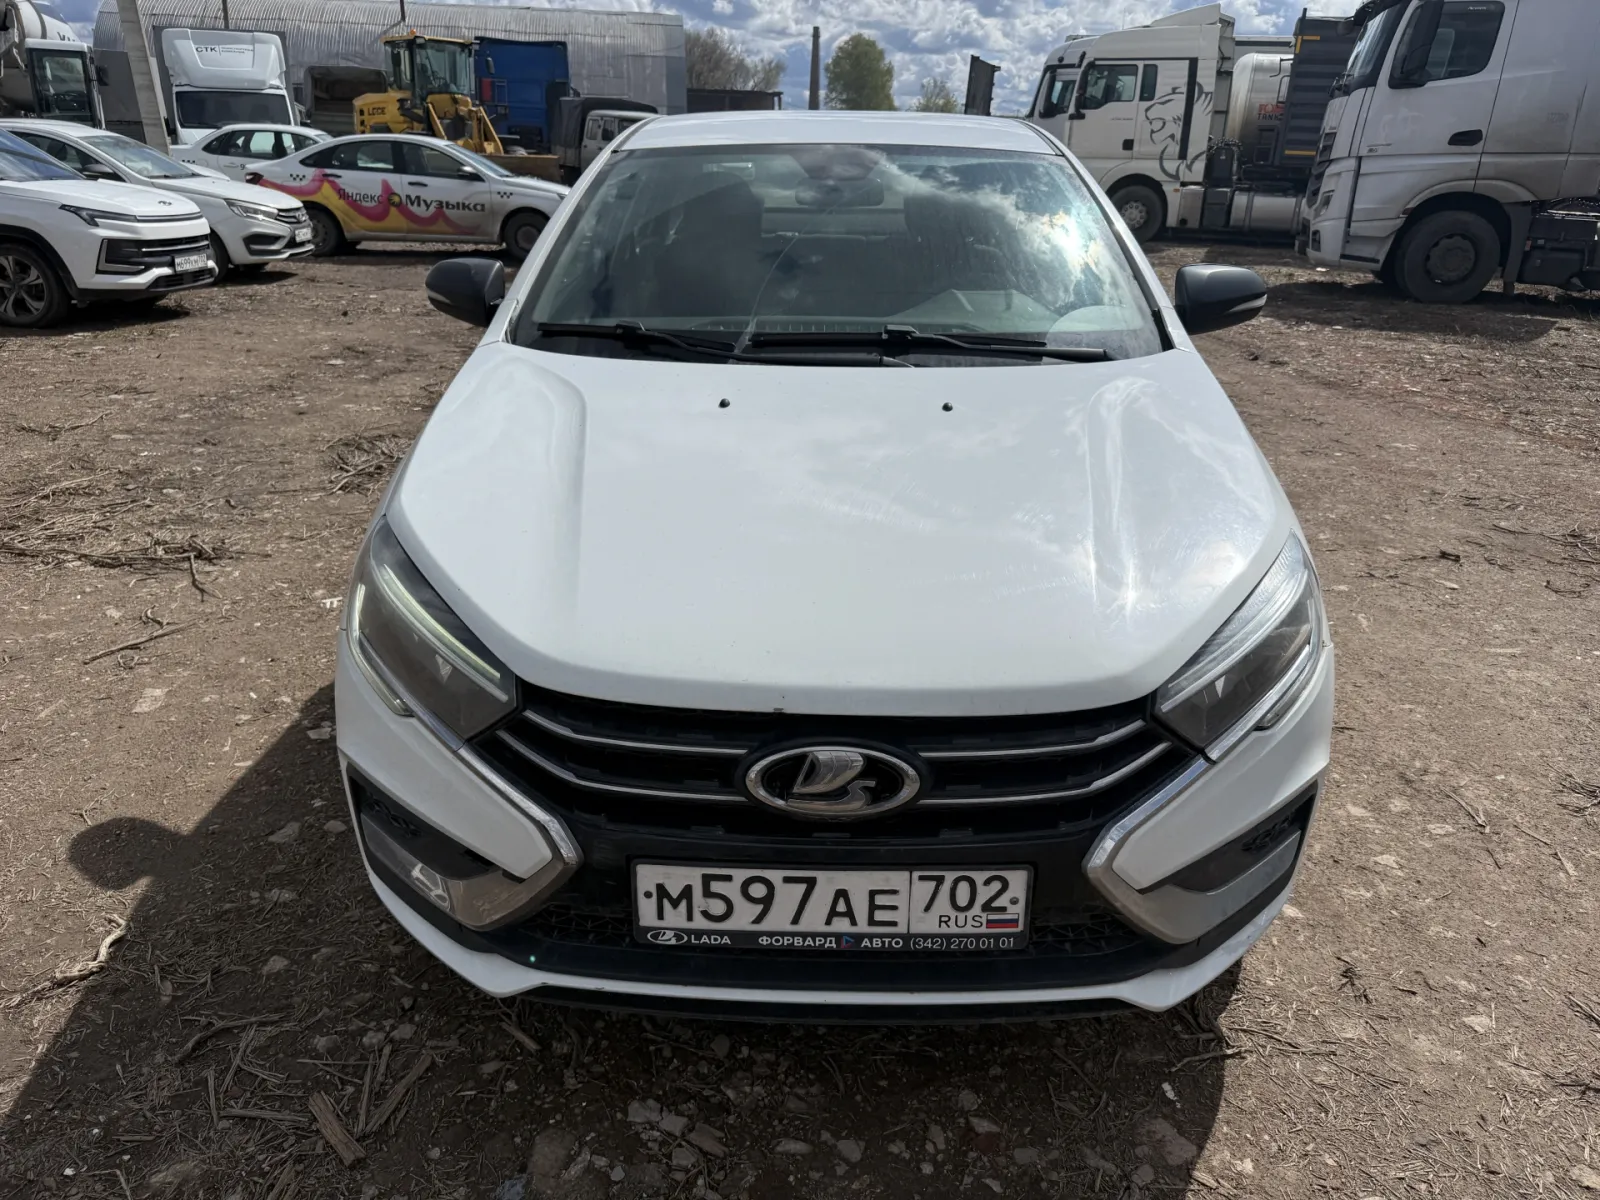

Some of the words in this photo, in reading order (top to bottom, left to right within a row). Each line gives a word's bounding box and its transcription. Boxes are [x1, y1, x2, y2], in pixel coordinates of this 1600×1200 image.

[338, 188, 385, 205] Яндекс
[405, 194, 486, 213] Музыка
[655, 873, 899, 926] М597АЕ
[918, 874, 1010, 913] 702
[938, 914, 984, 929] RUS
[691, 934, 732, 945] LADA
[758, 936, 837, 948] ФОРВАРД
[861, 937, 904, 948] АВТО
[910, 937, 947, 949] (342)
[951, 937, 976, 948] 270
[979, 937, 995, 948] 01
[999, 936, 1014, 948] 01
